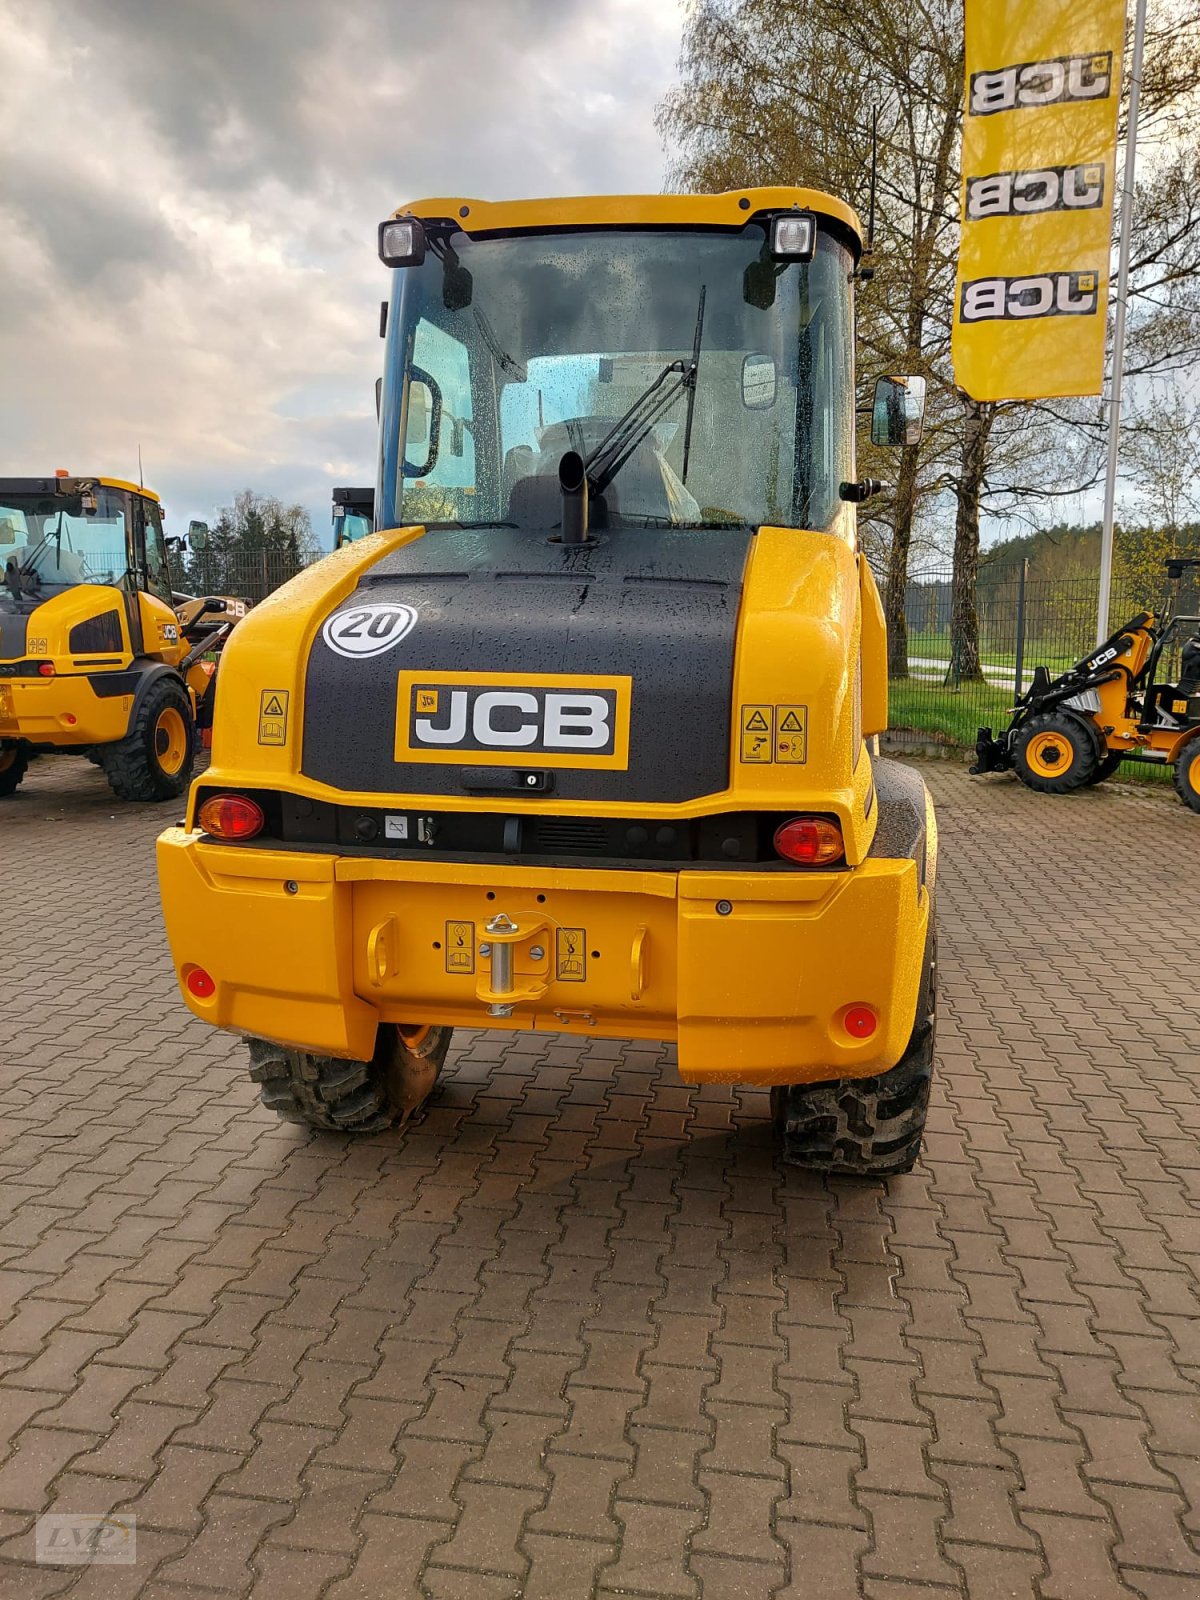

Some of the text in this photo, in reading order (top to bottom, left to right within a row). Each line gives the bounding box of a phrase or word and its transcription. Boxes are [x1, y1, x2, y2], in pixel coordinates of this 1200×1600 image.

[164, 625, 176, 639] JCB
[338, 612, 402, 638] 20
[1088, 647, 1117, 670] JCB
[415, 691, 609, 748] JCB
